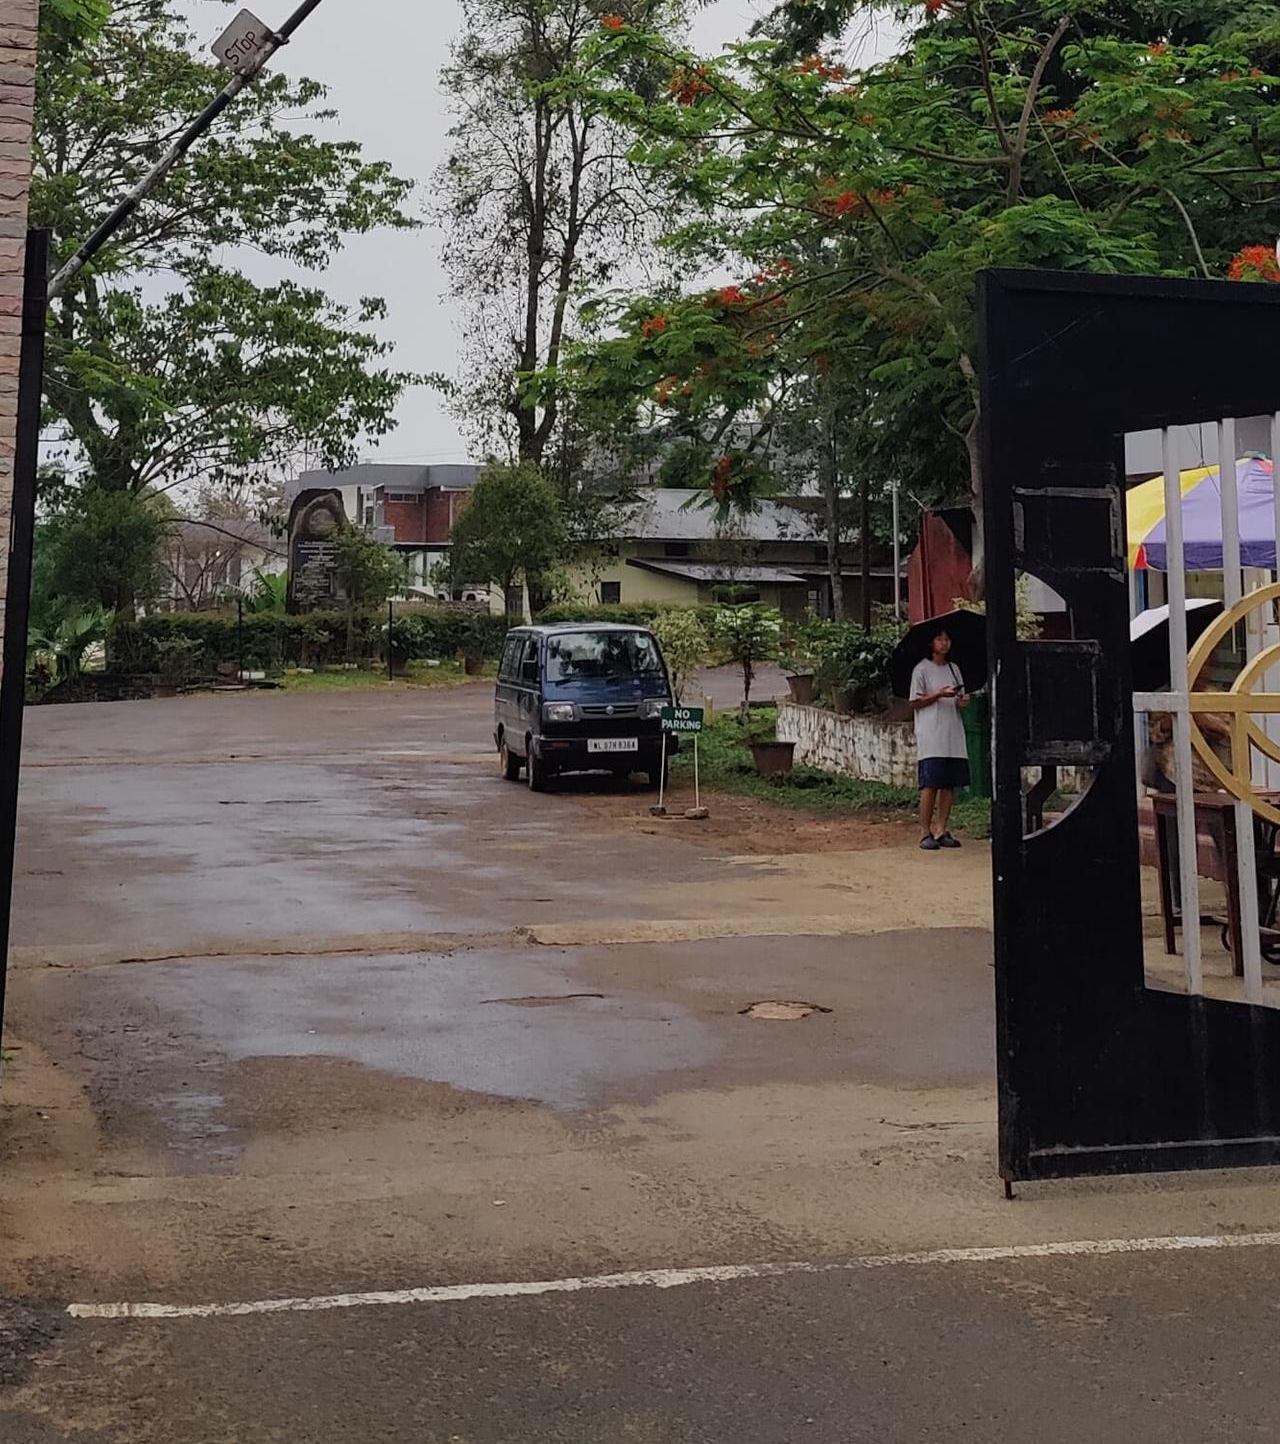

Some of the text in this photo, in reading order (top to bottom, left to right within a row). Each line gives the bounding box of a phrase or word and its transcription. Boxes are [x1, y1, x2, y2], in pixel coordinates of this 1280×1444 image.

[224, 31, 258, 64] STOP
[674, 710, 690, 719] NO
[661, 719, 702, 730] PARKING
